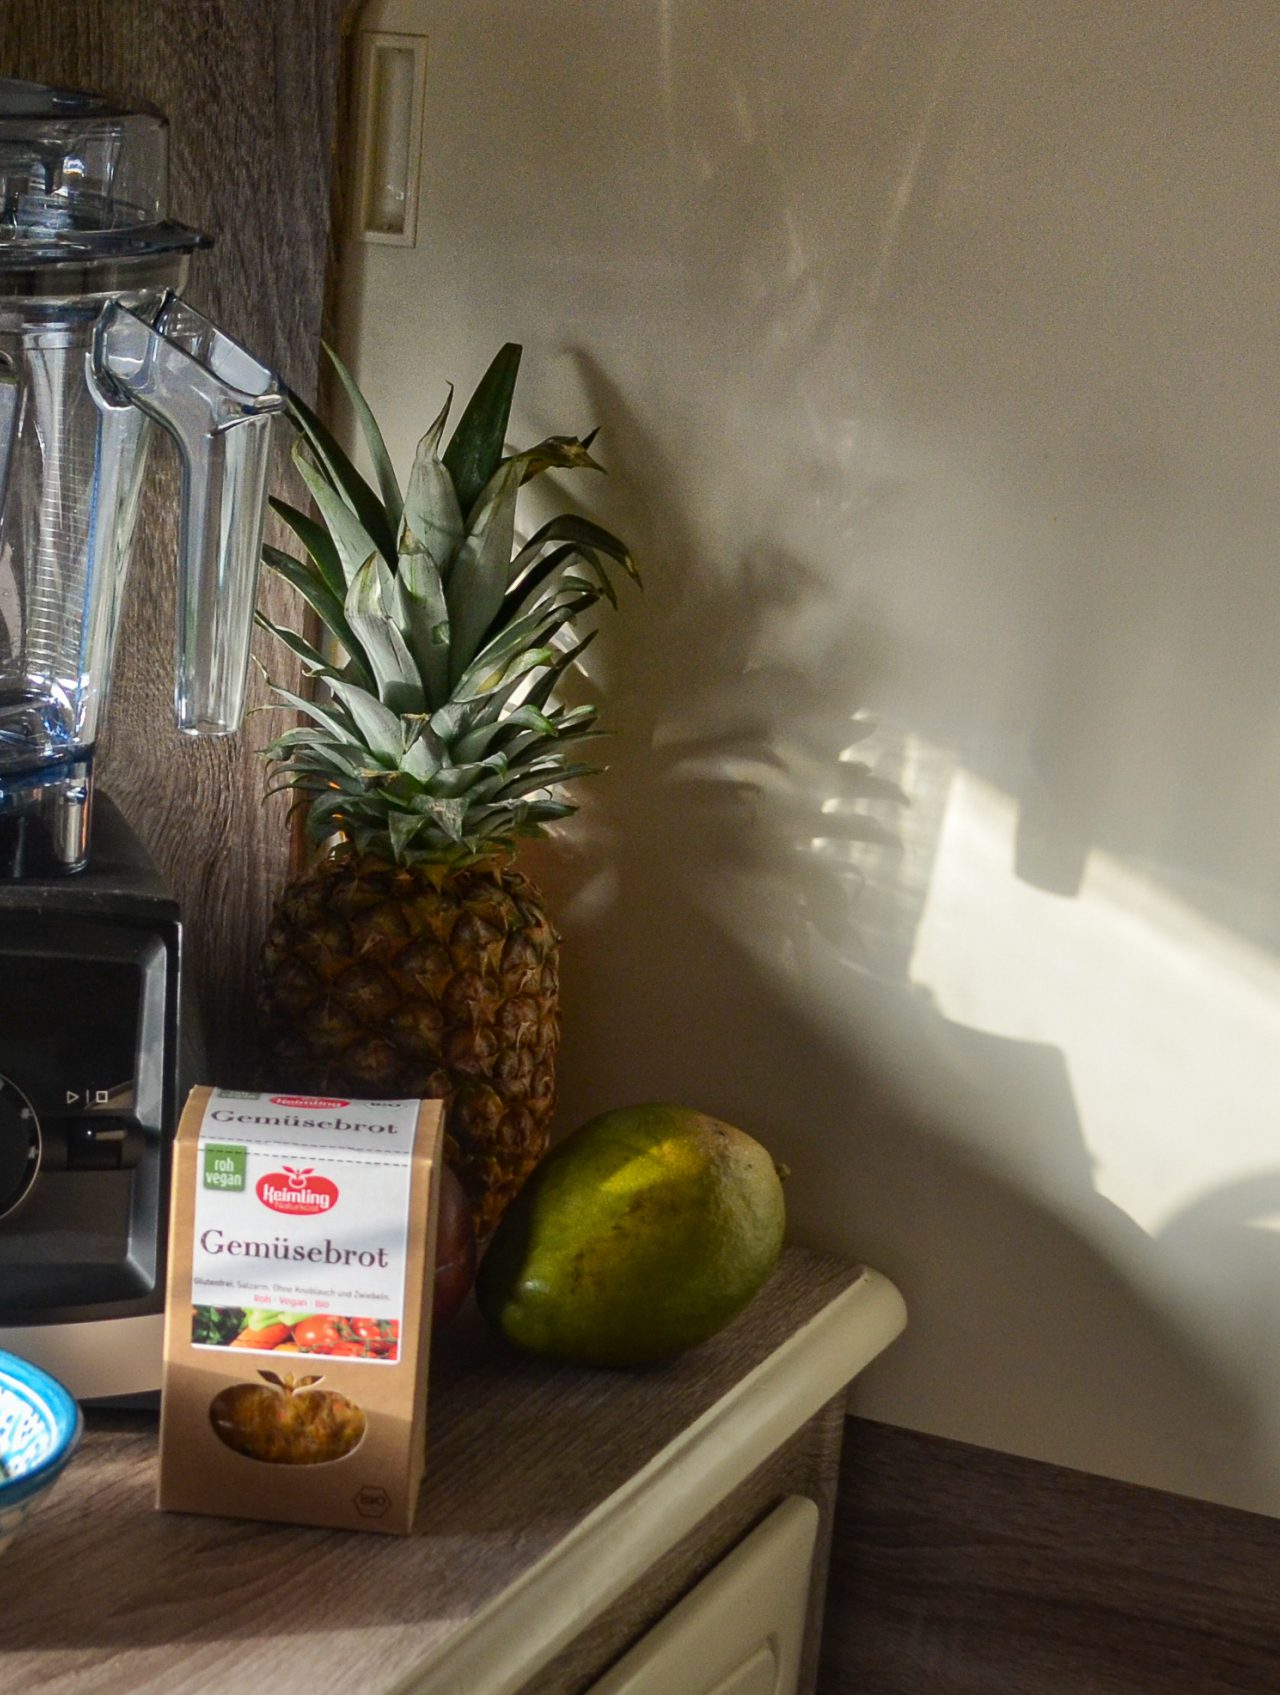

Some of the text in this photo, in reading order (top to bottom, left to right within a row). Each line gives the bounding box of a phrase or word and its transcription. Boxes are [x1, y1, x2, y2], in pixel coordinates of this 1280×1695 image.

[210, 1109, 399, 1135] Gemüsebrot
[214, 1156, 234, 1172] roh
[206, 1171, 242, 1188] vegan
[199, 1228, 389, 1269] Gemüsebrot
[272, 1282, 293, 1293] Ohne
[337, 1288, 353, 1298] und
[253, 1293, 331, 1309] Roh Vegan Bio
